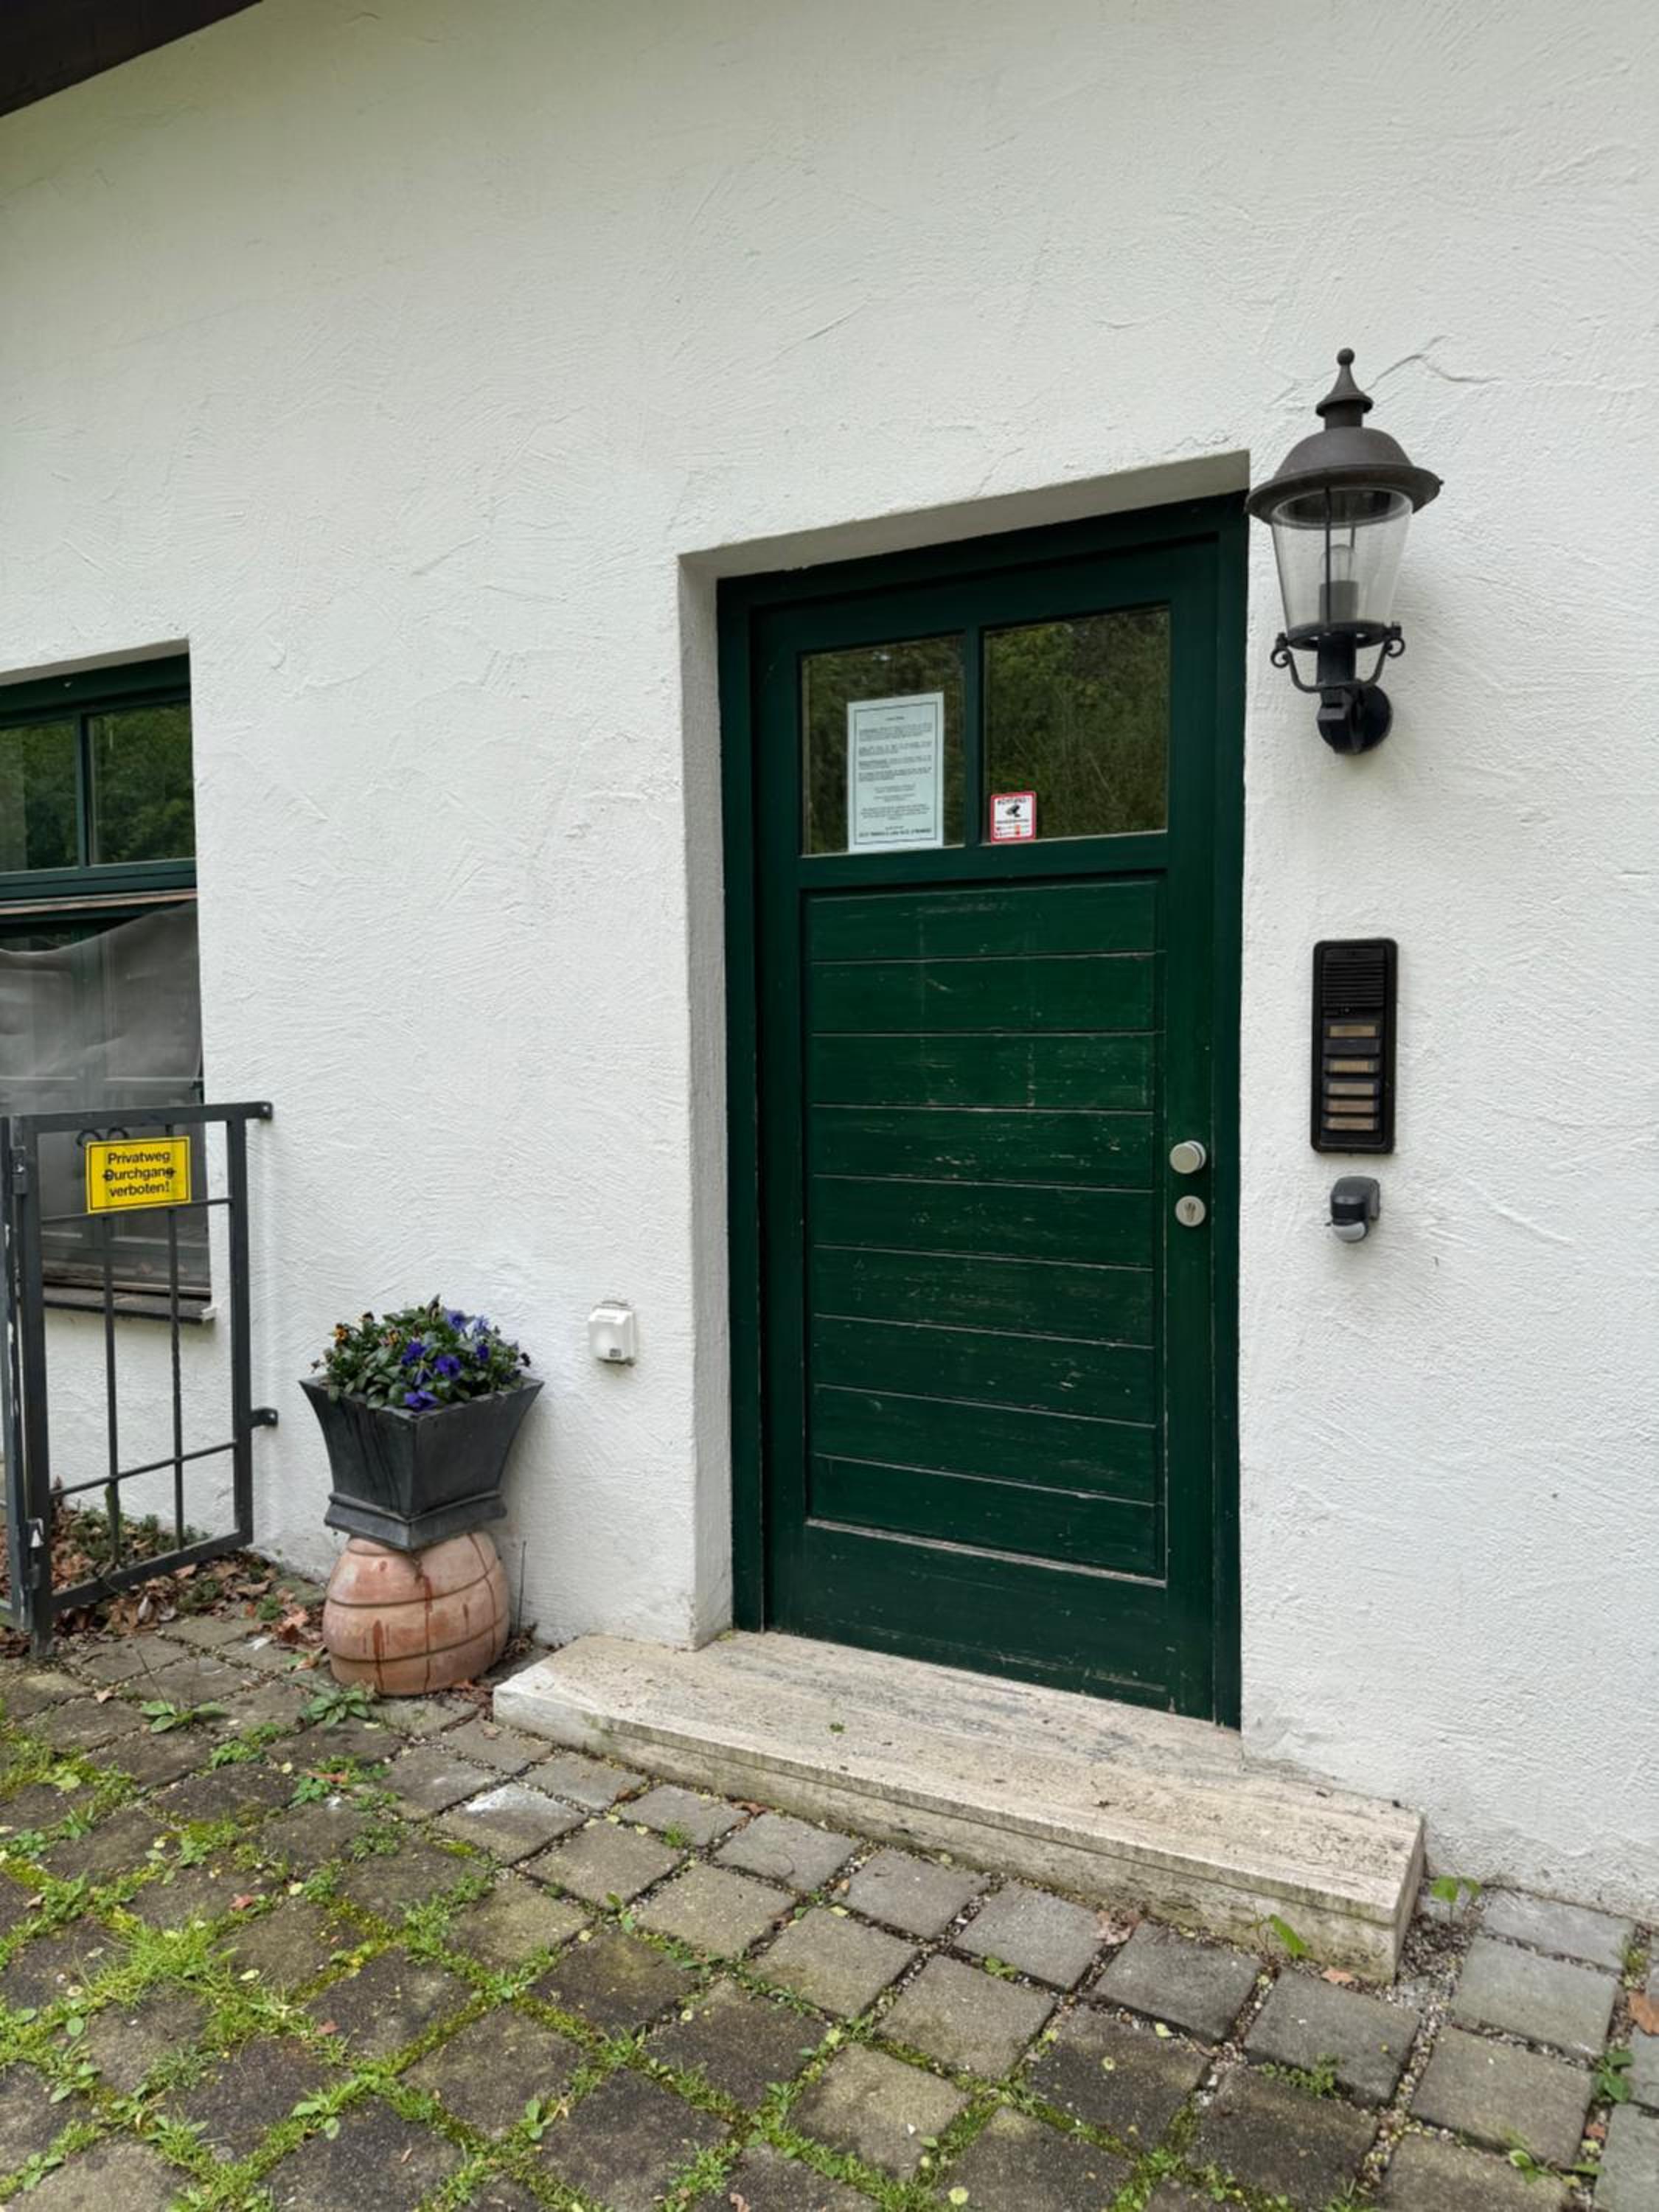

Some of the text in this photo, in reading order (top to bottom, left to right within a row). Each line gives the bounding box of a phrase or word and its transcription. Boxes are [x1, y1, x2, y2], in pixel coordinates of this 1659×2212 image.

[107, 1151, 170, 1164] Privatweg
[105, 1167, 174, 1181] Durchgang
[109, 1181, 169, 1197] verboten!
